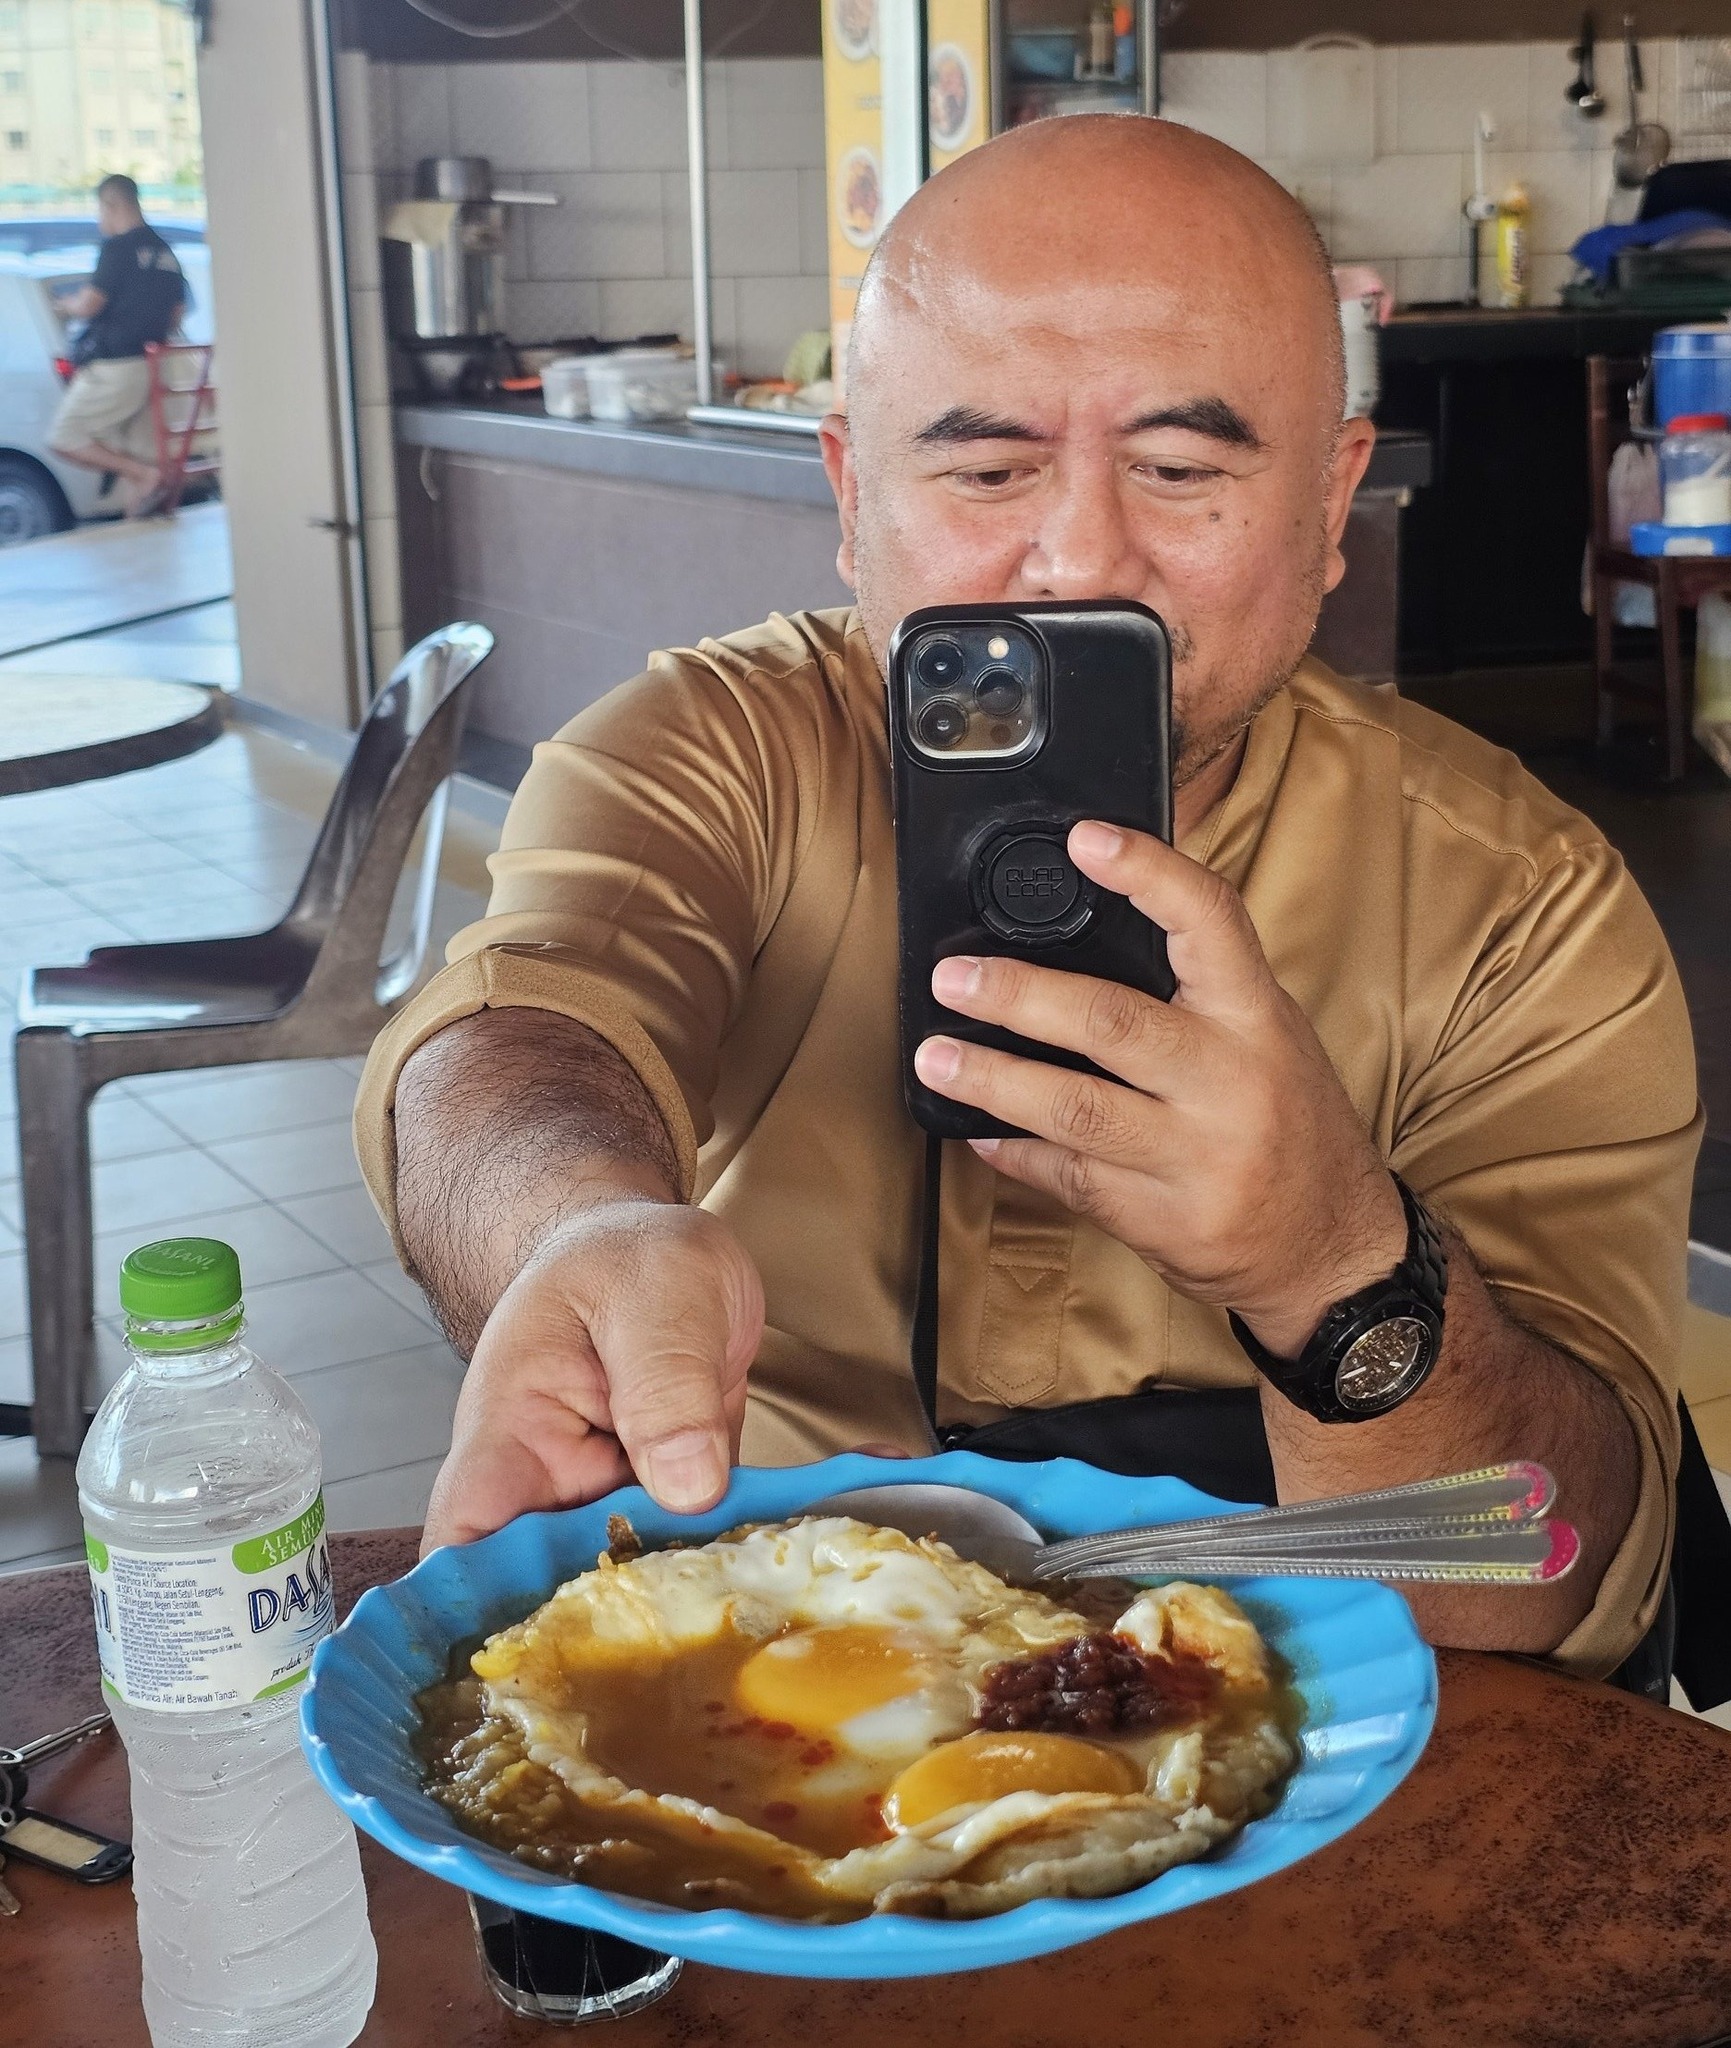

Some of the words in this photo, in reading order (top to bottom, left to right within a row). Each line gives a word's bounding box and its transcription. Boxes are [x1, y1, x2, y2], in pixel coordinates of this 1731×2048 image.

[1006, 866, 1065, 882] QUAD
[1006, 881, 1065, 897] LOCK
[261, 1530, 295, 1555] AIR
[153, 1578, 172, 1588] Source
[175, 1693, 185, 1704] Air
[187, 1692, 213, 1704] Bawah
[214, 1688, 238, 1700] Tanah
